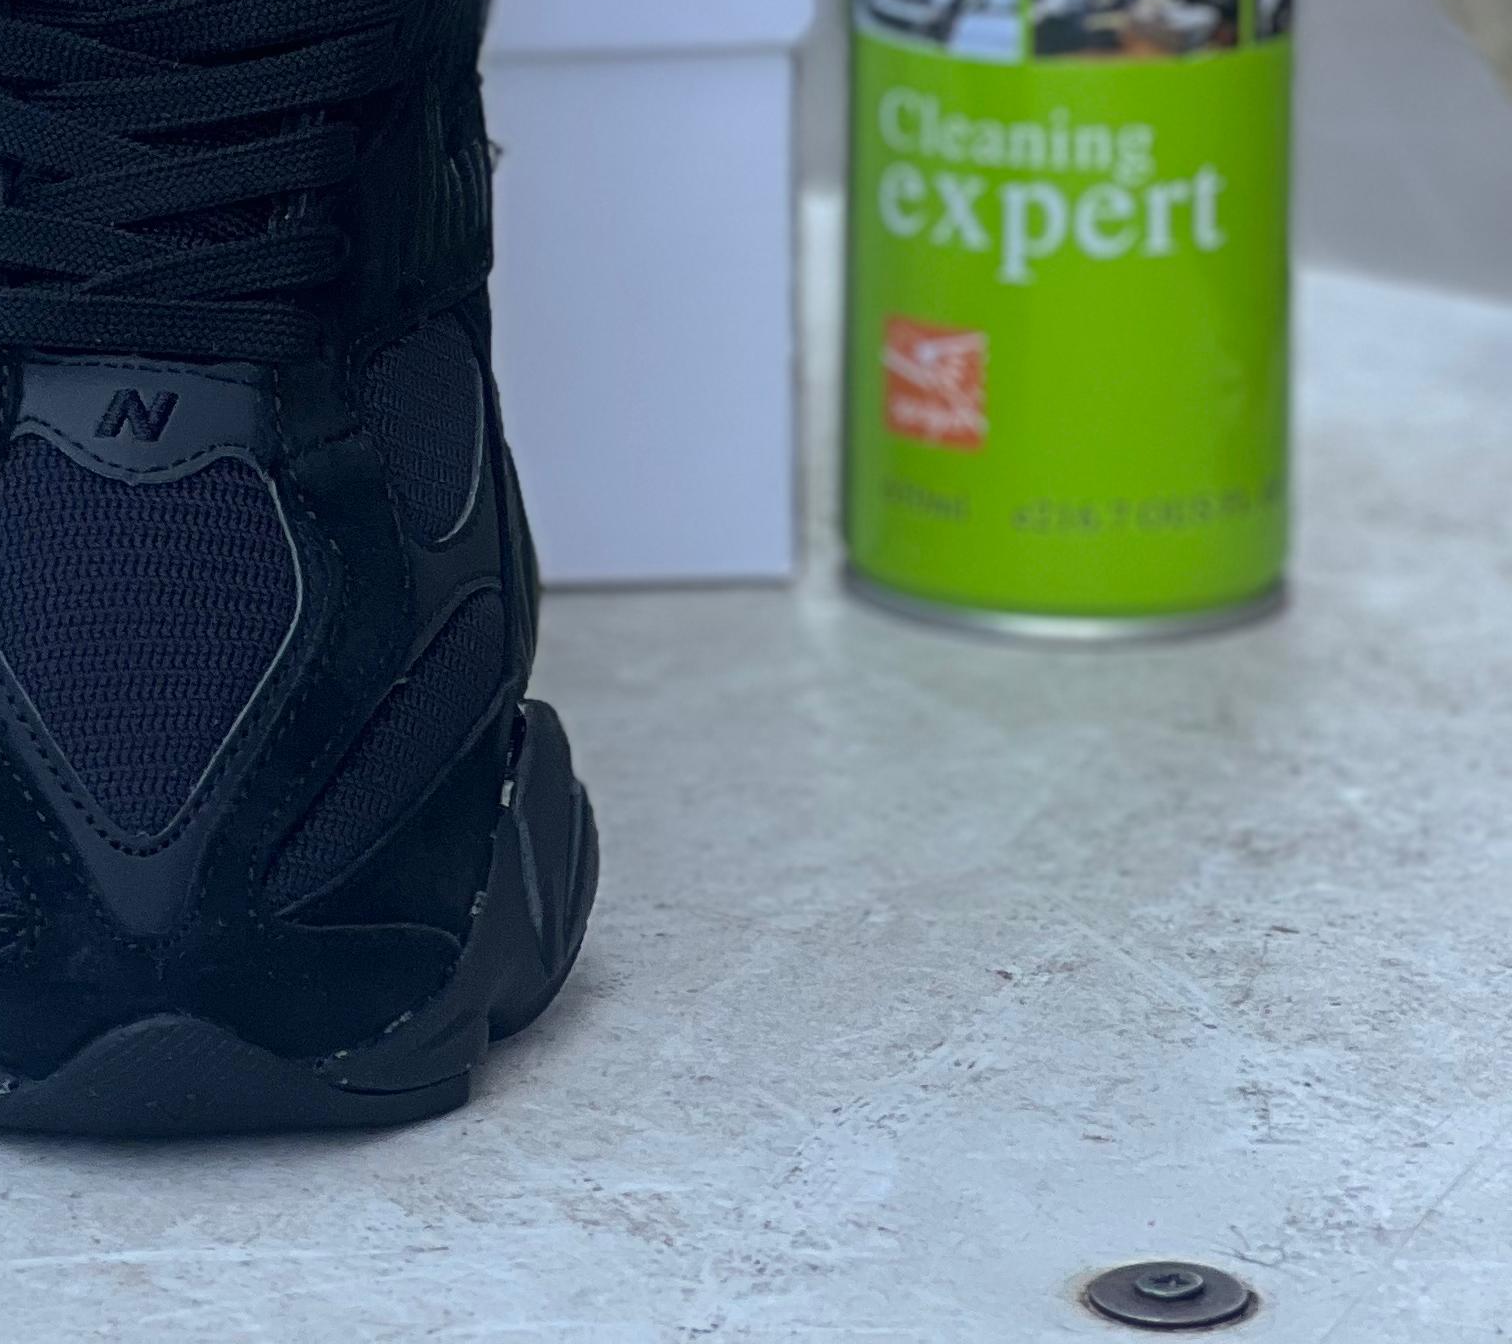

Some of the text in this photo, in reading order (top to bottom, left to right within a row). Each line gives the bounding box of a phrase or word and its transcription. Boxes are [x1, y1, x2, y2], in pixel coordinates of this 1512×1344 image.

[878, 86, 1155, 187] Cleaning
[878, 162, 1227, 285] expert
[93, 388, 180, 442] N
